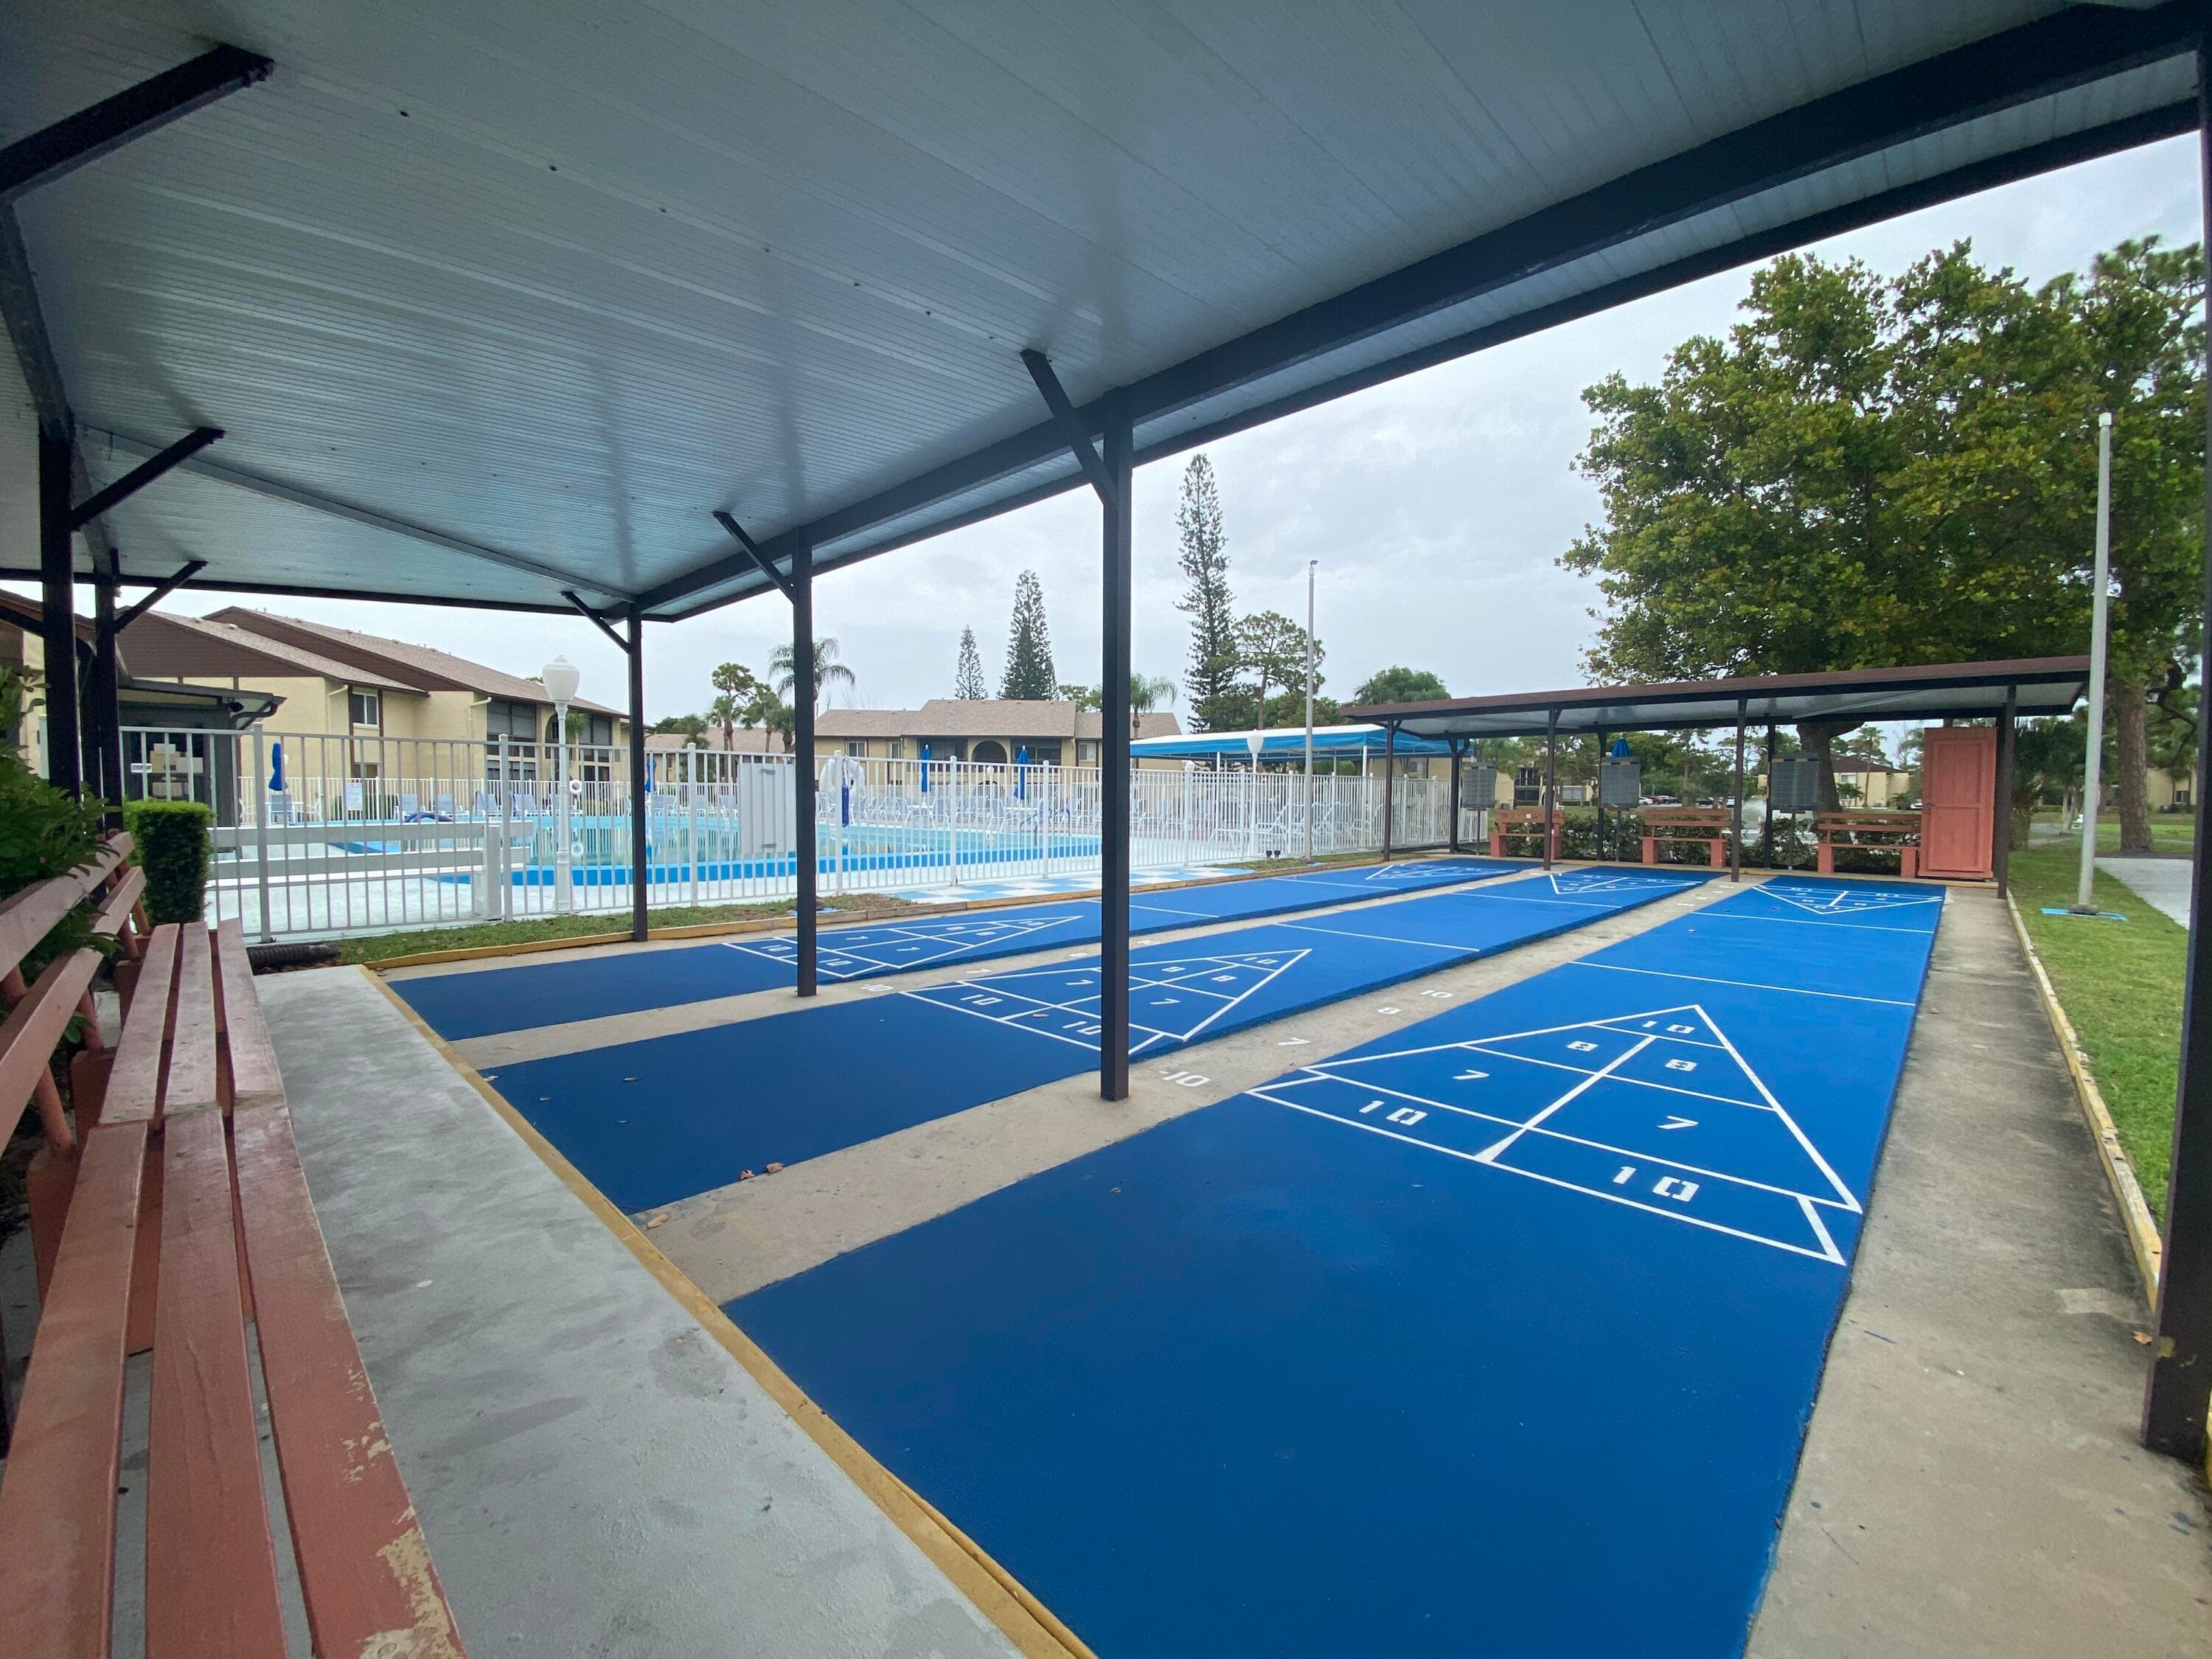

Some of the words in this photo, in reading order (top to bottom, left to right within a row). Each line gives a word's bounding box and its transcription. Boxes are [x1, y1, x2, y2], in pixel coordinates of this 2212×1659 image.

[1244, 957, 1279, 965] 10
[960, 994, 1004, 1006] 10
[1420, 990, 1453, 998] 10
[1062, 1020, 1102, 1035] 10
[1642, 1020, 1695, 1034] 10
[1278, 1037, 1311, 1046] 7
[1567, 1040, 1598, 1052] 8
[1665, 1059, 1697, 1071] 8
[1158, 1071, 1211, 1087] -10
[1453, 1069, 1490, 1080] 7
[1359, 1100, 1428, 1126] 10
[1658, 1115, 1699, 1130] 7
[1613, 1166, 1700, 1202] 10
